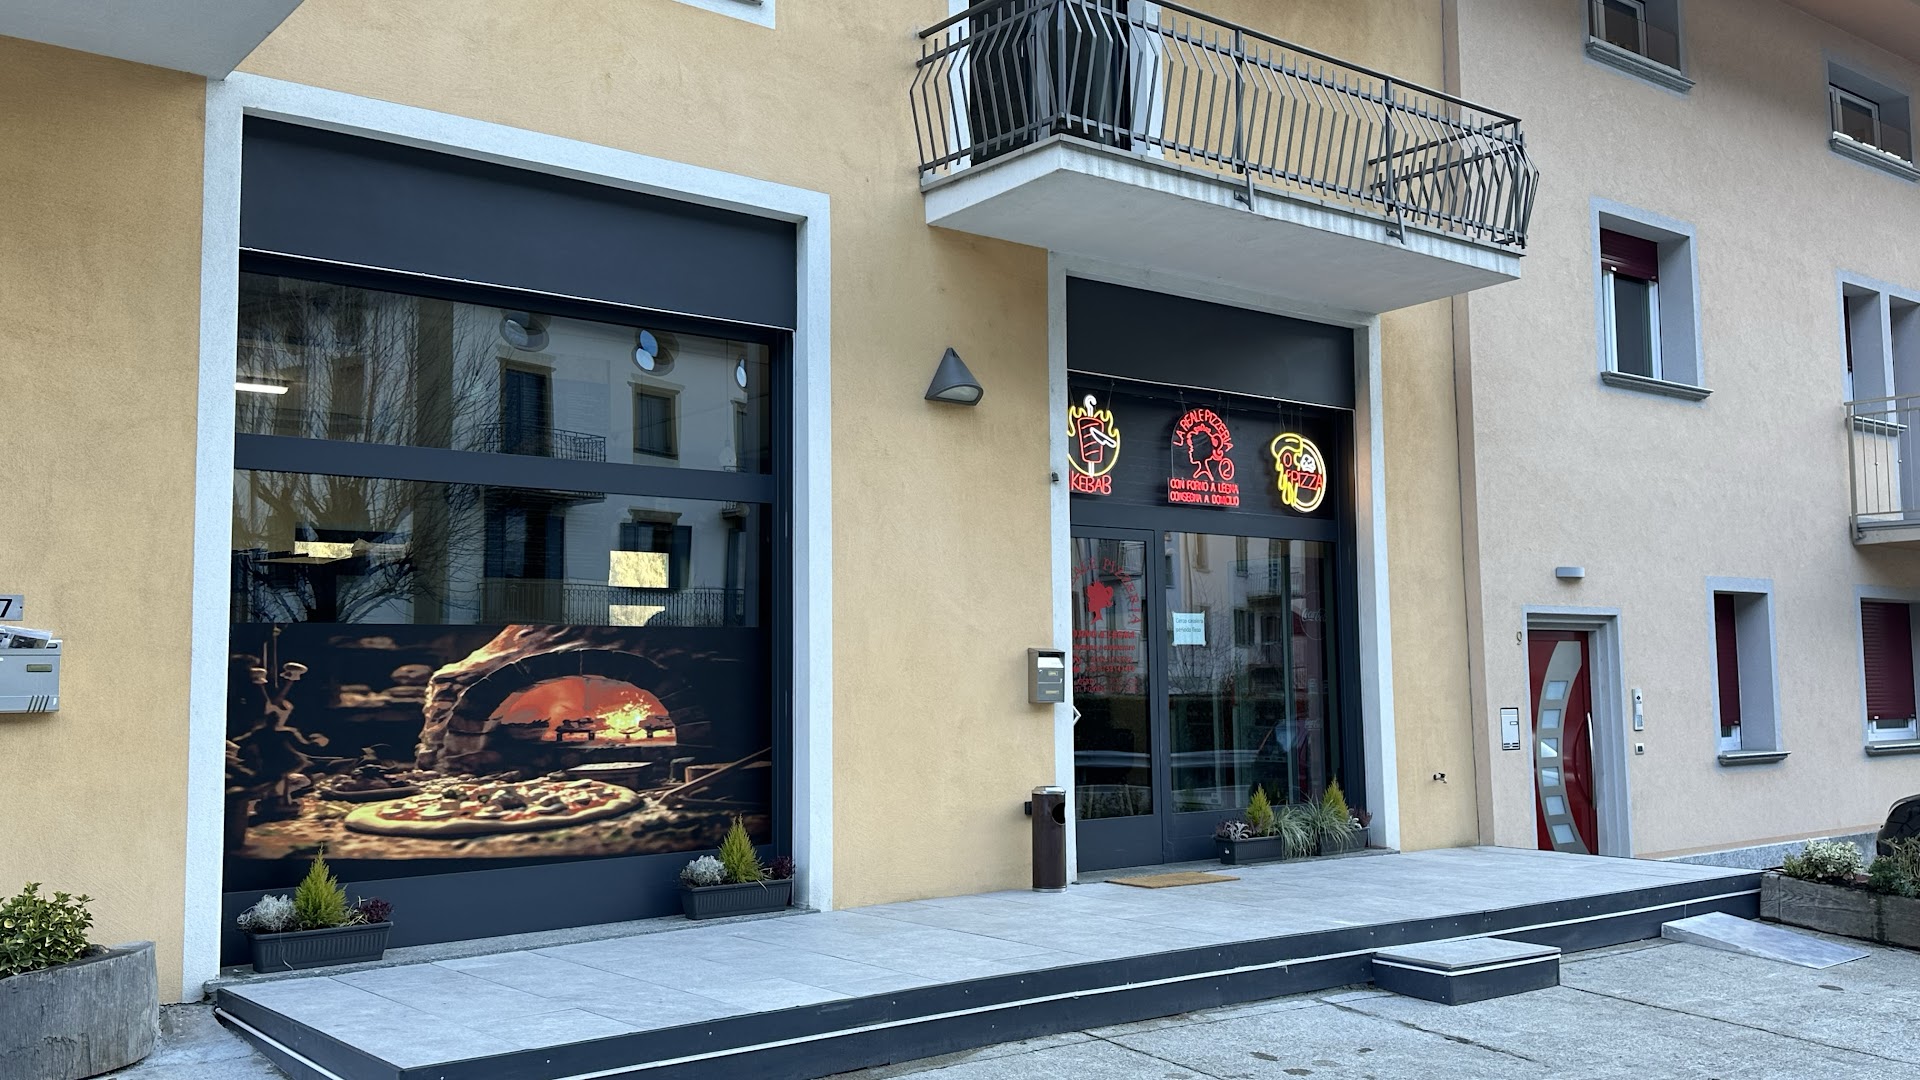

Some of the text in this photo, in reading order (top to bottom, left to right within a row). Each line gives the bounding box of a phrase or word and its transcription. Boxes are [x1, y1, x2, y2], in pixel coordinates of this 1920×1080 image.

[1172, 409, 1233, 452] LA REALE PIZZERIA
[1070, 472, 1112, 495] KEBAB
[1170, 479, 1239, 494] CON FORNO A LEGNA
[1291, 470, 1323, 491] PIZZA
[1170, 491, 1202, 503] CONSEGNA
[1204, 494, 1210, 504] A
